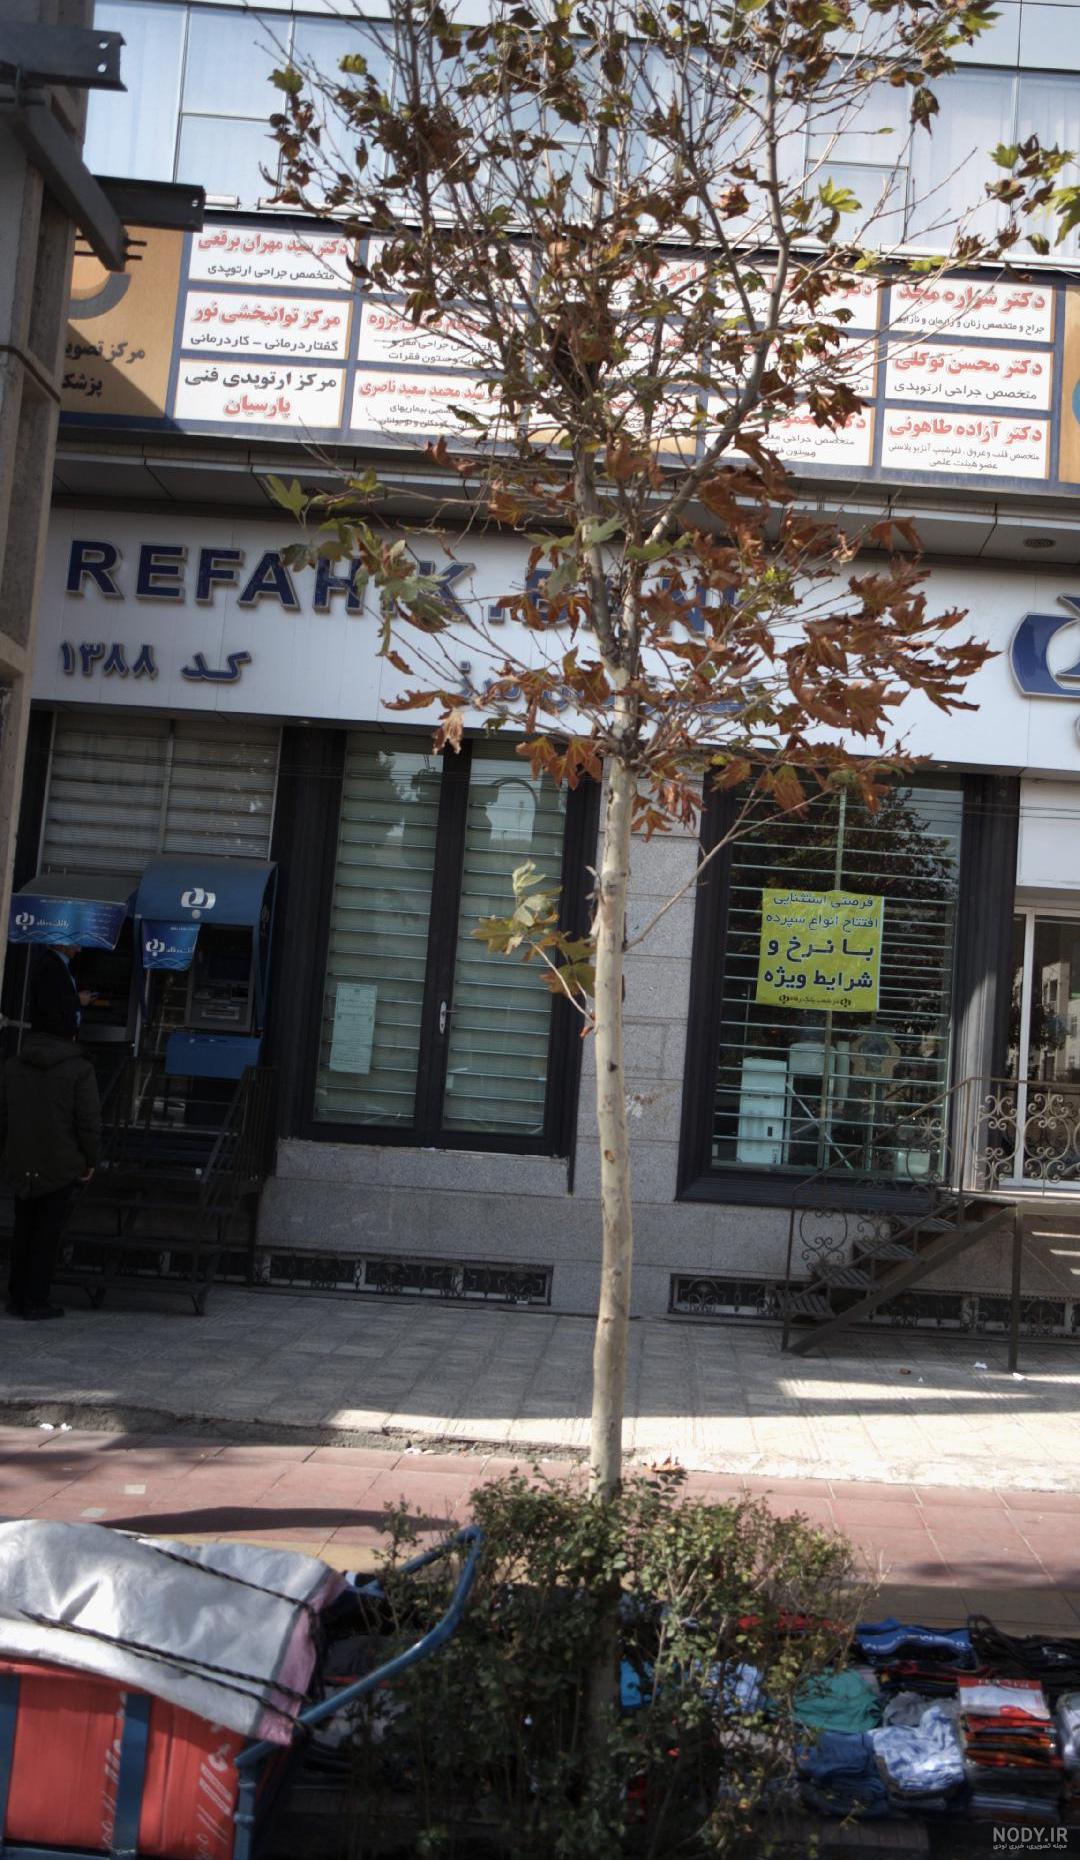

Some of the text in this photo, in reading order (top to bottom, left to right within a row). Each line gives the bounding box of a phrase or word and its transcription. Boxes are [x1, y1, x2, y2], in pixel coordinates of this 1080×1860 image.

[198, 230, 241, 252] برقعی
[243, 234, 283, 254] مهران
[207, 263, 335, 281] متخصص جراحی ارتوپدی
[1001, 291, 1046, 313] دکتر
[191, 301, 341, 330] مرکز توانبخشی نور
[982, 321, 1017, 331] متخصص
[103, 341, 146, 364] مرکز
[893, 351, 1043, 380] دکتر محسن توکلی
[184, 366, 337, 392] مرکز ارتوپدی فنی
[359, 380, 396, 398] ناصری
[398, 385, 427, 399] سعید
[429, 386, 460, 399] محمد
[894, 382, 1037, 400] متخصص جراحی ارتوپدی
[223, 394, 291, 418] پارسیان
[955, 421, 1002, 443] آزاده
[1005, 426, 1043, 444] دکتر
[60, 640, 252, 682] کد ۱۳۸۸
[830, 897, 873, 910] فرصتی
[766, 914, 878, 933] افتتاح انواع سپرده
[767, 936, 874, 963] با نرخ و
[764, 966, 873, 992] شرایط ویژه
